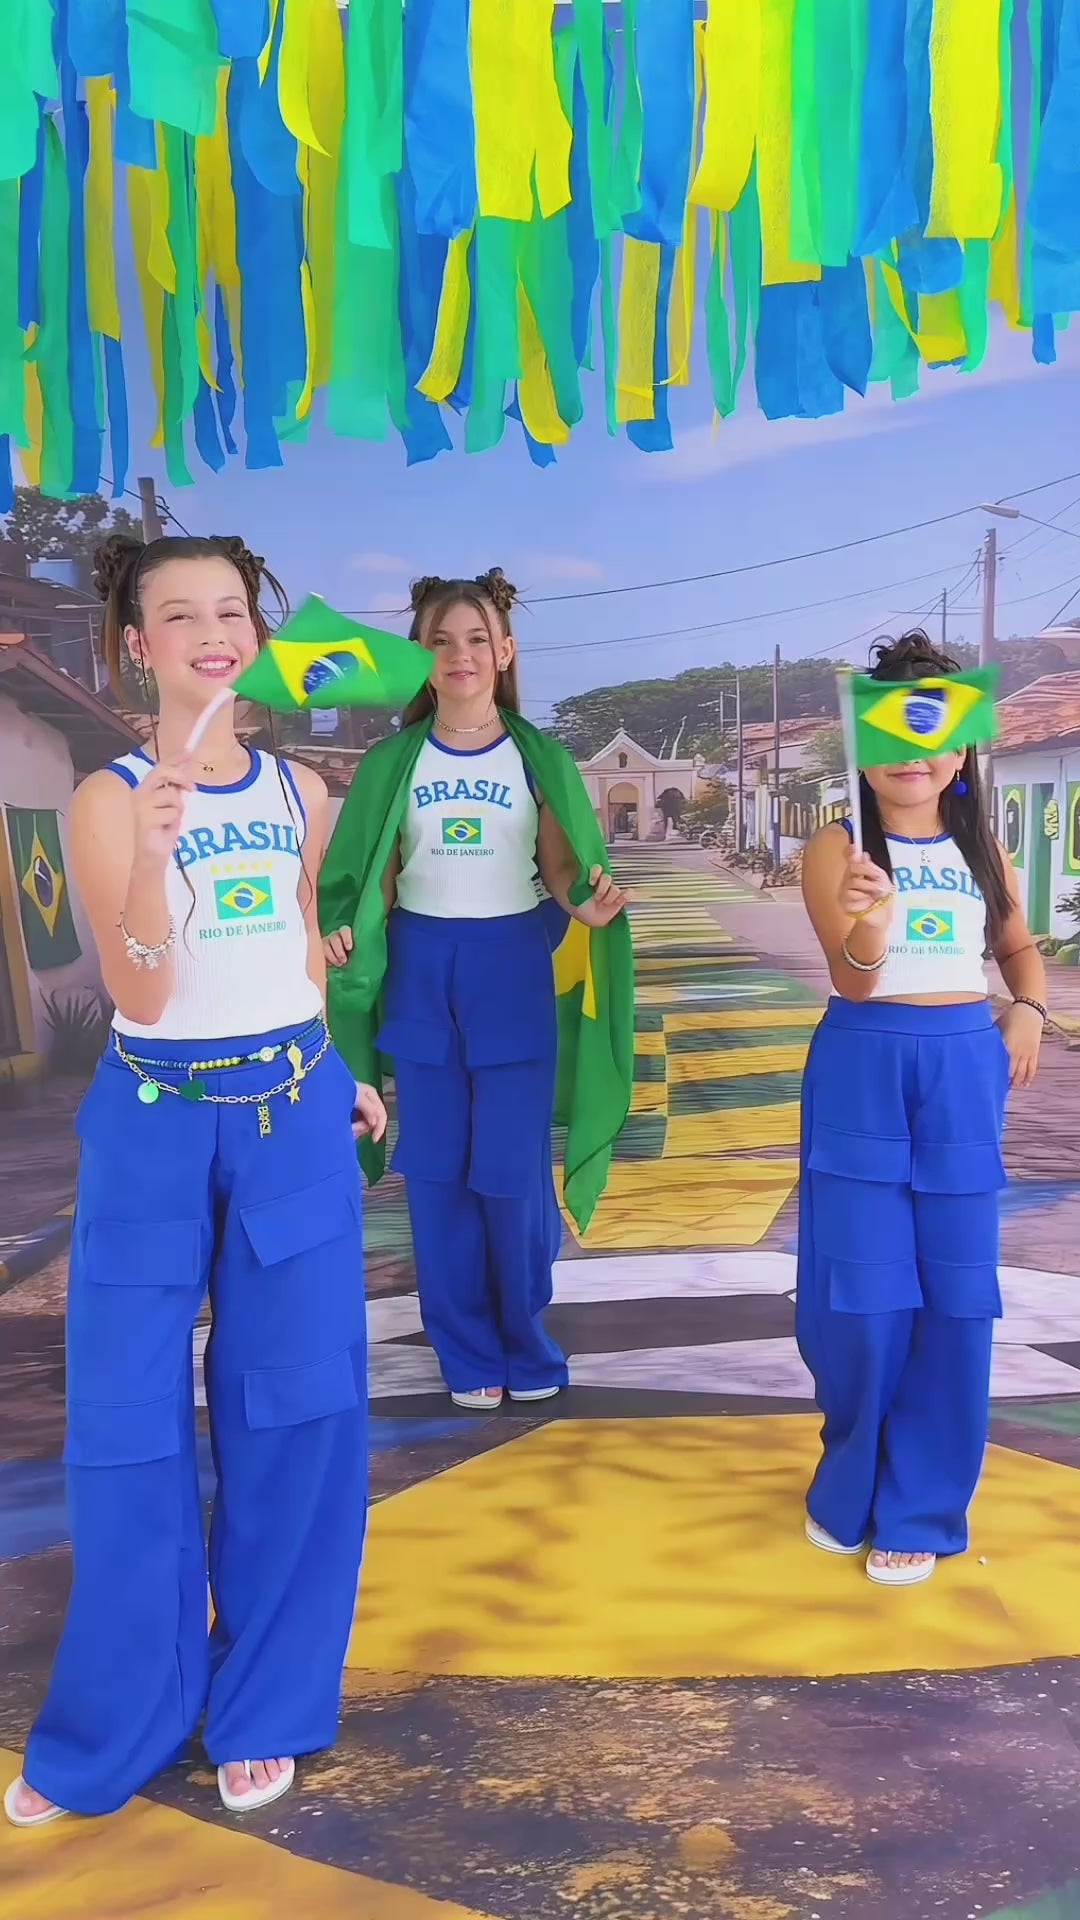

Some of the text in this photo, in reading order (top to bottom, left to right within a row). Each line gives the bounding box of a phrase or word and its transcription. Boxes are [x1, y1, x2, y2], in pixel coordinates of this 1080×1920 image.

[413, 778, 512, 810] BRASIL
[173, 820, 299, 870] BRASIL
[431, 848, 495, 857] RIO DE JANEIRO
[892, 865, 982, 902] RASIL
[199, 920, 287, 940] RIO DE JANEIRO
[888, 945, 908, 954] RIO
